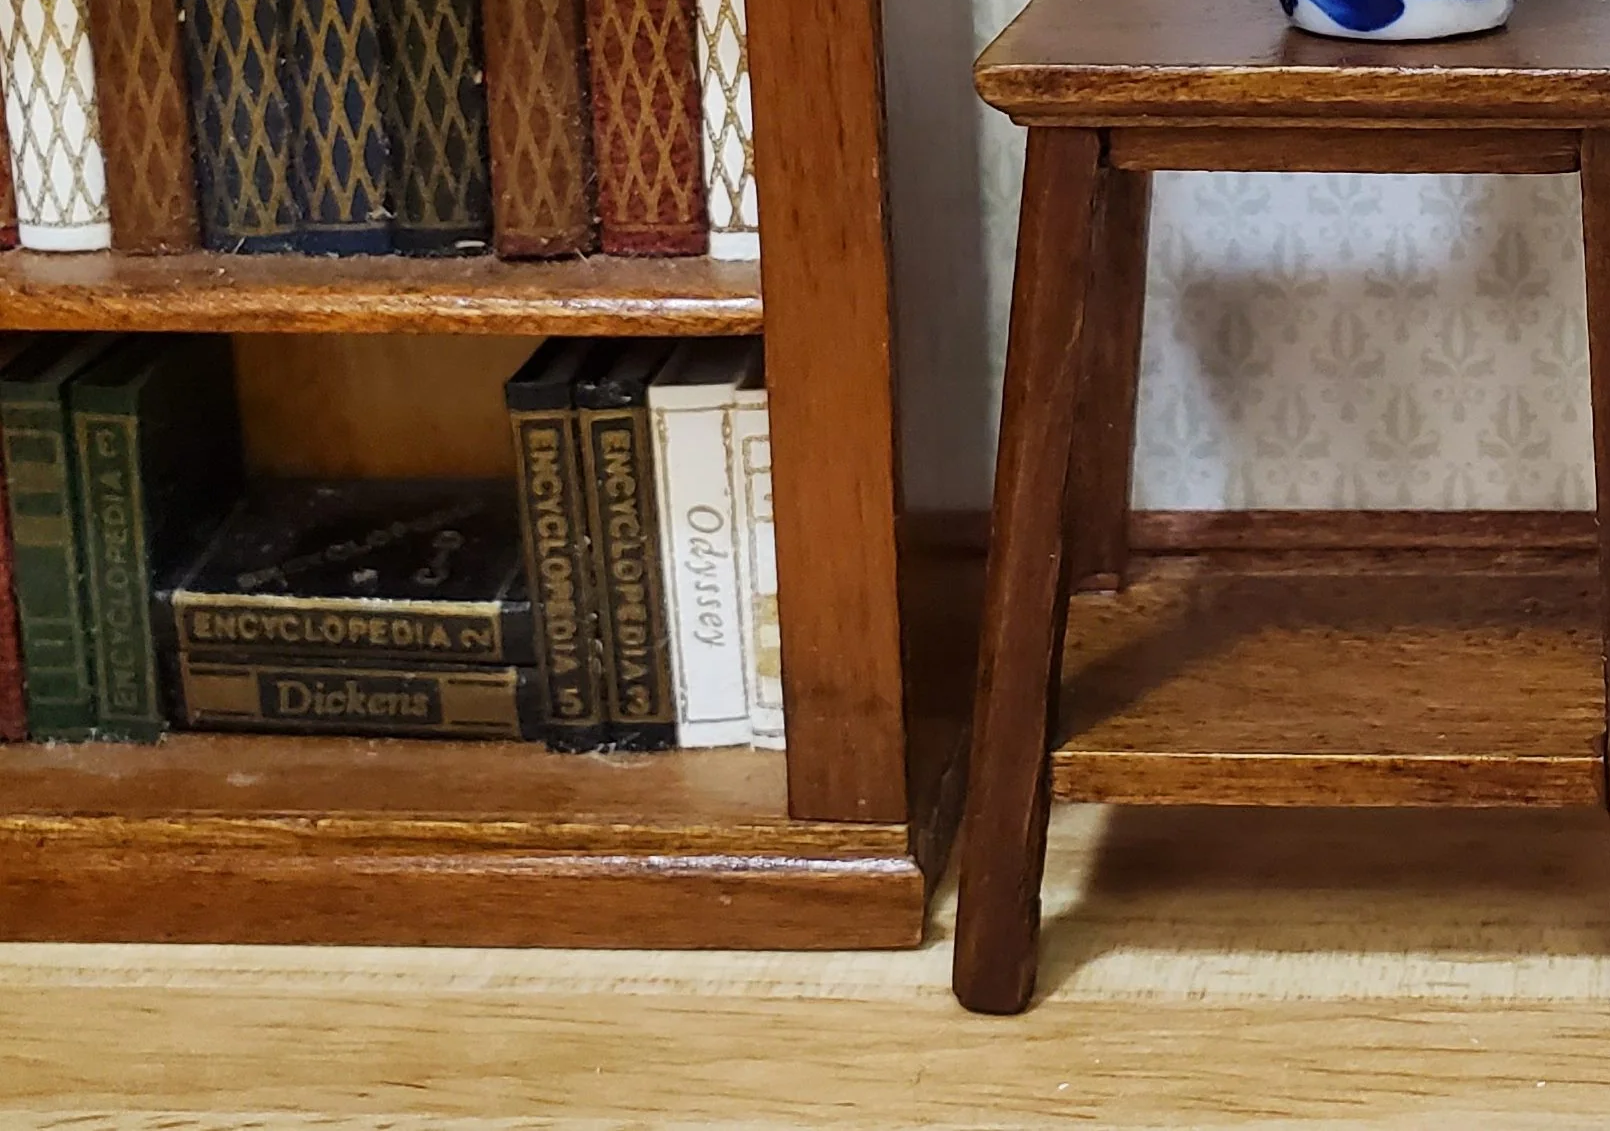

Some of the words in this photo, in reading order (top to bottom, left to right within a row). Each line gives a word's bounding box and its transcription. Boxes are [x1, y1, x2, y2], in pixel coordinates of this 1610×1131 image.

[98, 469, 138, 709] ENCYCLOPEDIA
[193, 612, 450, 648] ENCYCLOPEDIA
[527, 428, 582, 675] ENCYCLOPEDIA
[601, 429, 651, 681] ENCYCLOPEDIA
[686, 504, 726, 650] Odyssey
[276, 679, 430, 717] Dickens
